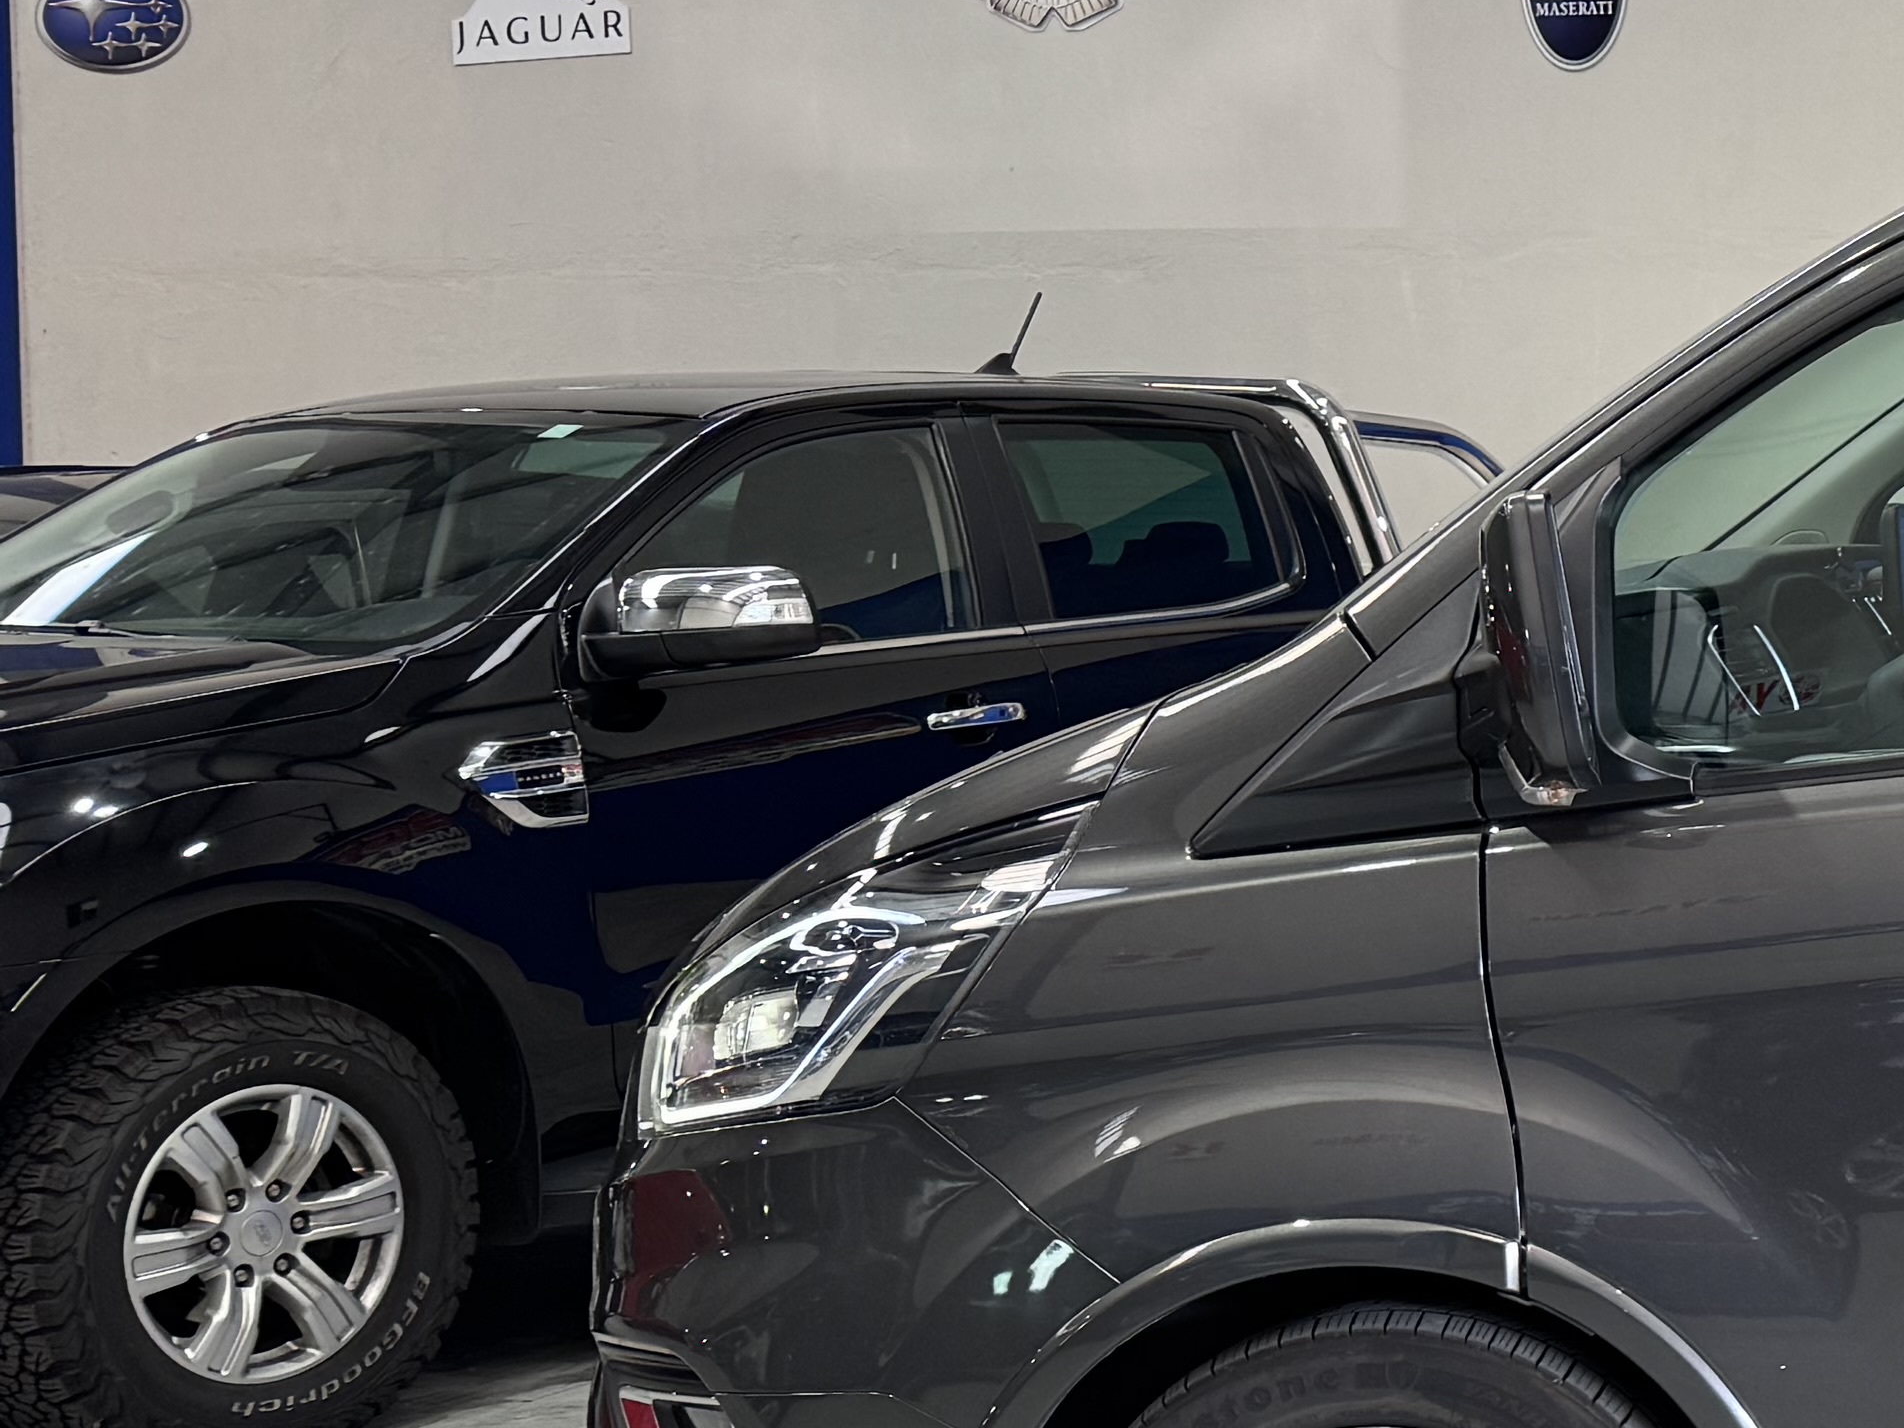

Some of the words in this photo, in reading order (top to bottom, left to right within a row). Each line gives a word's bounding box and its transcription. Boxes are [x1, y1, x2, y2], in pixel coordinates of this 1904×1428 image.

[456, 9, 624, 55] JAGUAR
[1535, 0, 1614, 17] MASERATI
[105, 1053, 273, 1223] All-Terrain
[292, 1049, 350, 1077] T/A
[230, 1271, 431, 1417] BFGoodrich
